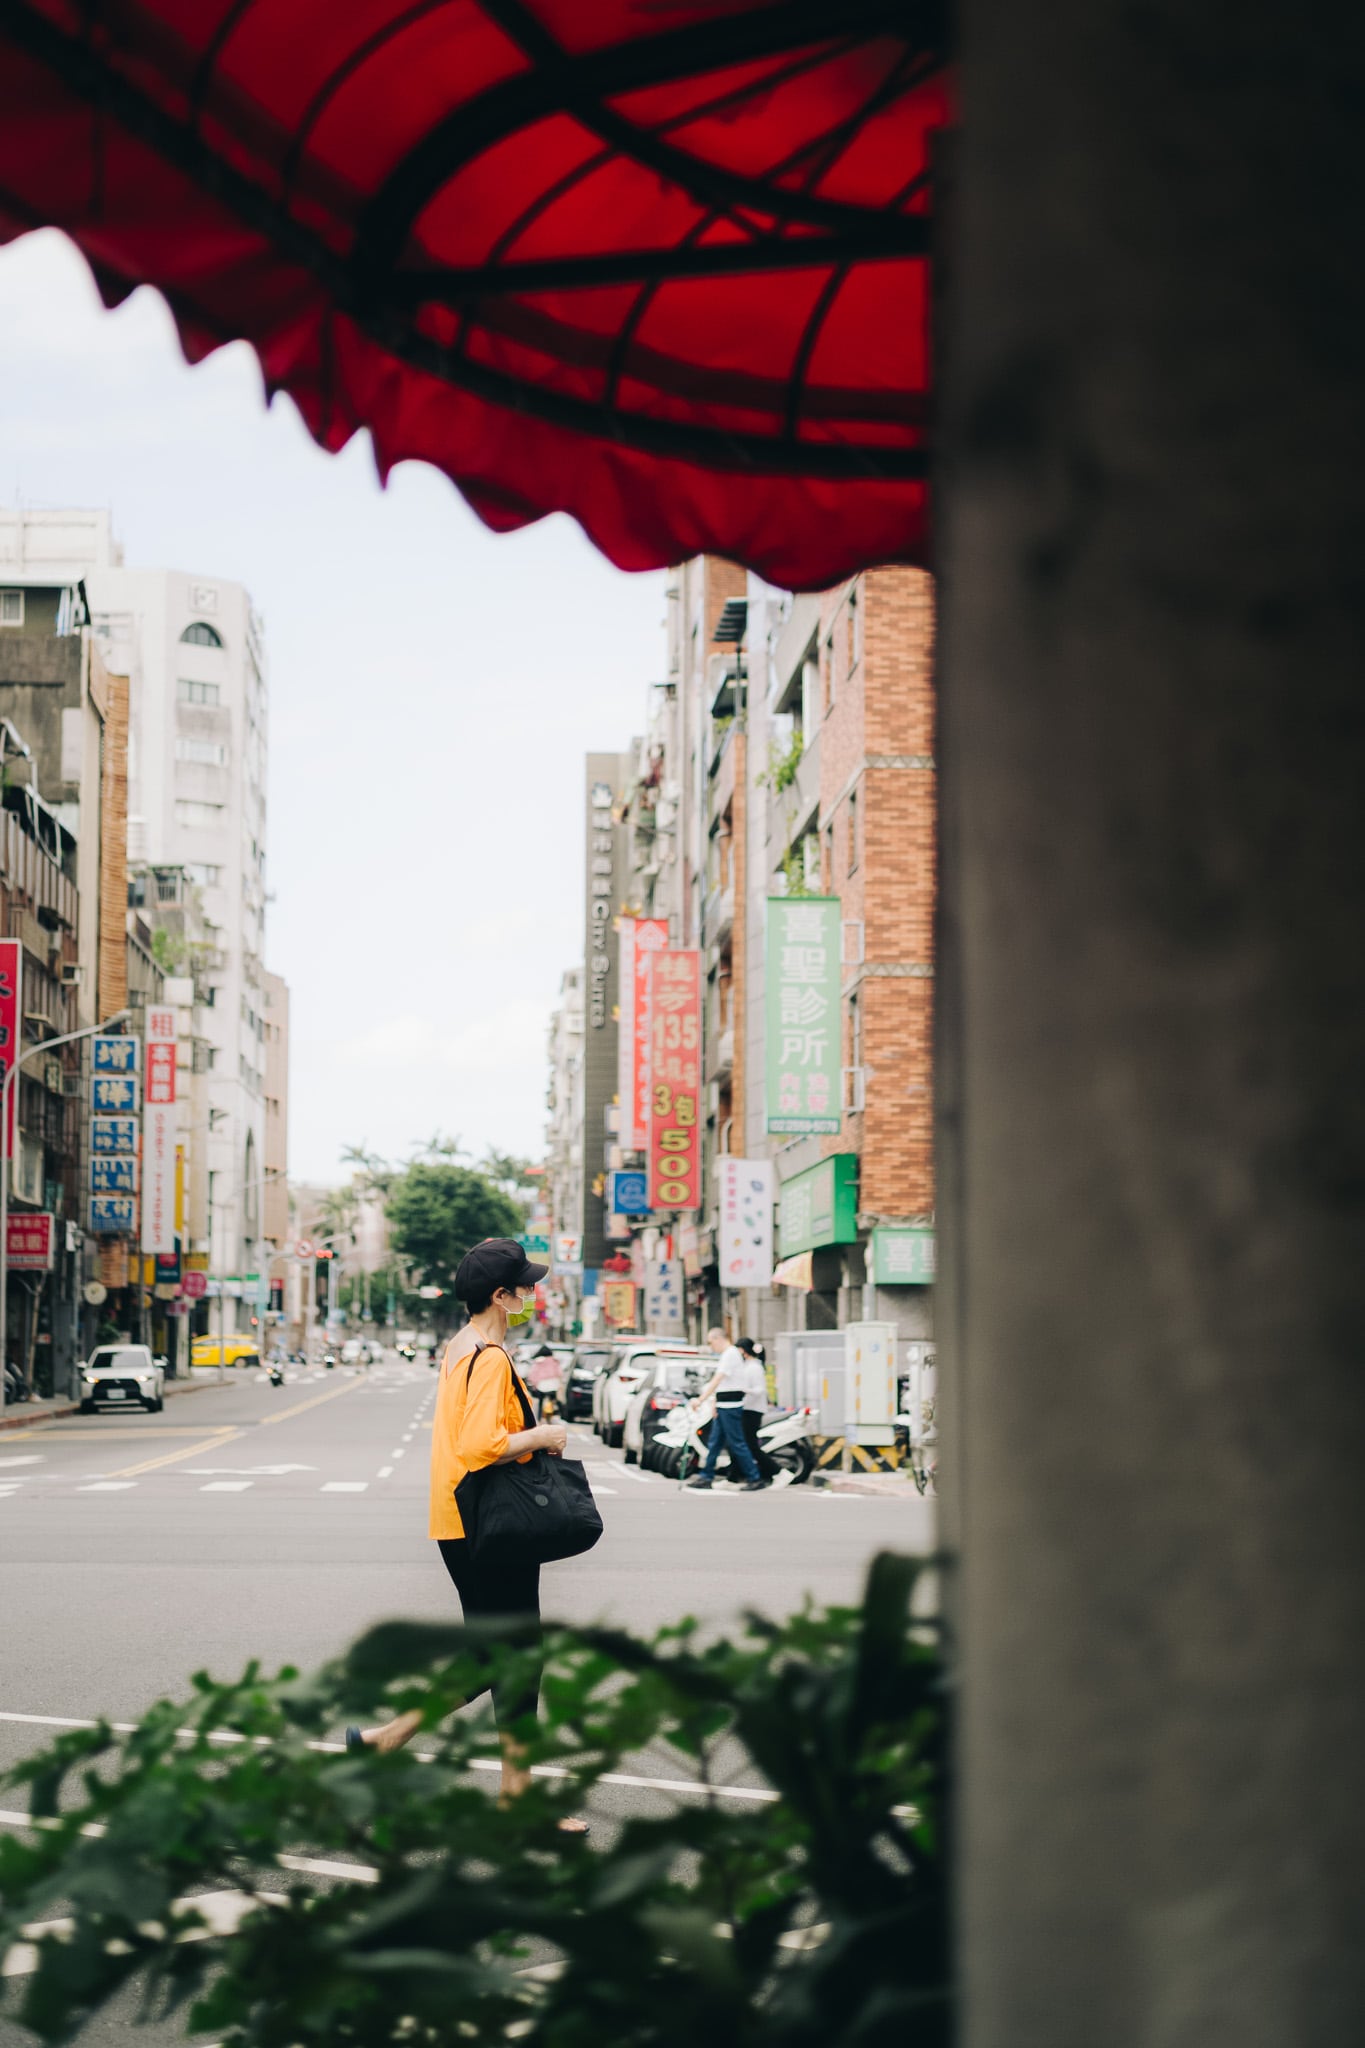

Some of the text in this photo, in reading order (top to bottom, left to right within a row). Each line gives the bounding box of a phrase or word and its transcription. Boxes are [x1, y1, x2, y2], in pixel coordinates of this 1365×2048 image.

[779, 904, 828, 1066] 喜聖診所
[653, 1014, 698, 1050] 135
[657, 1128, 693, 1204] 500
